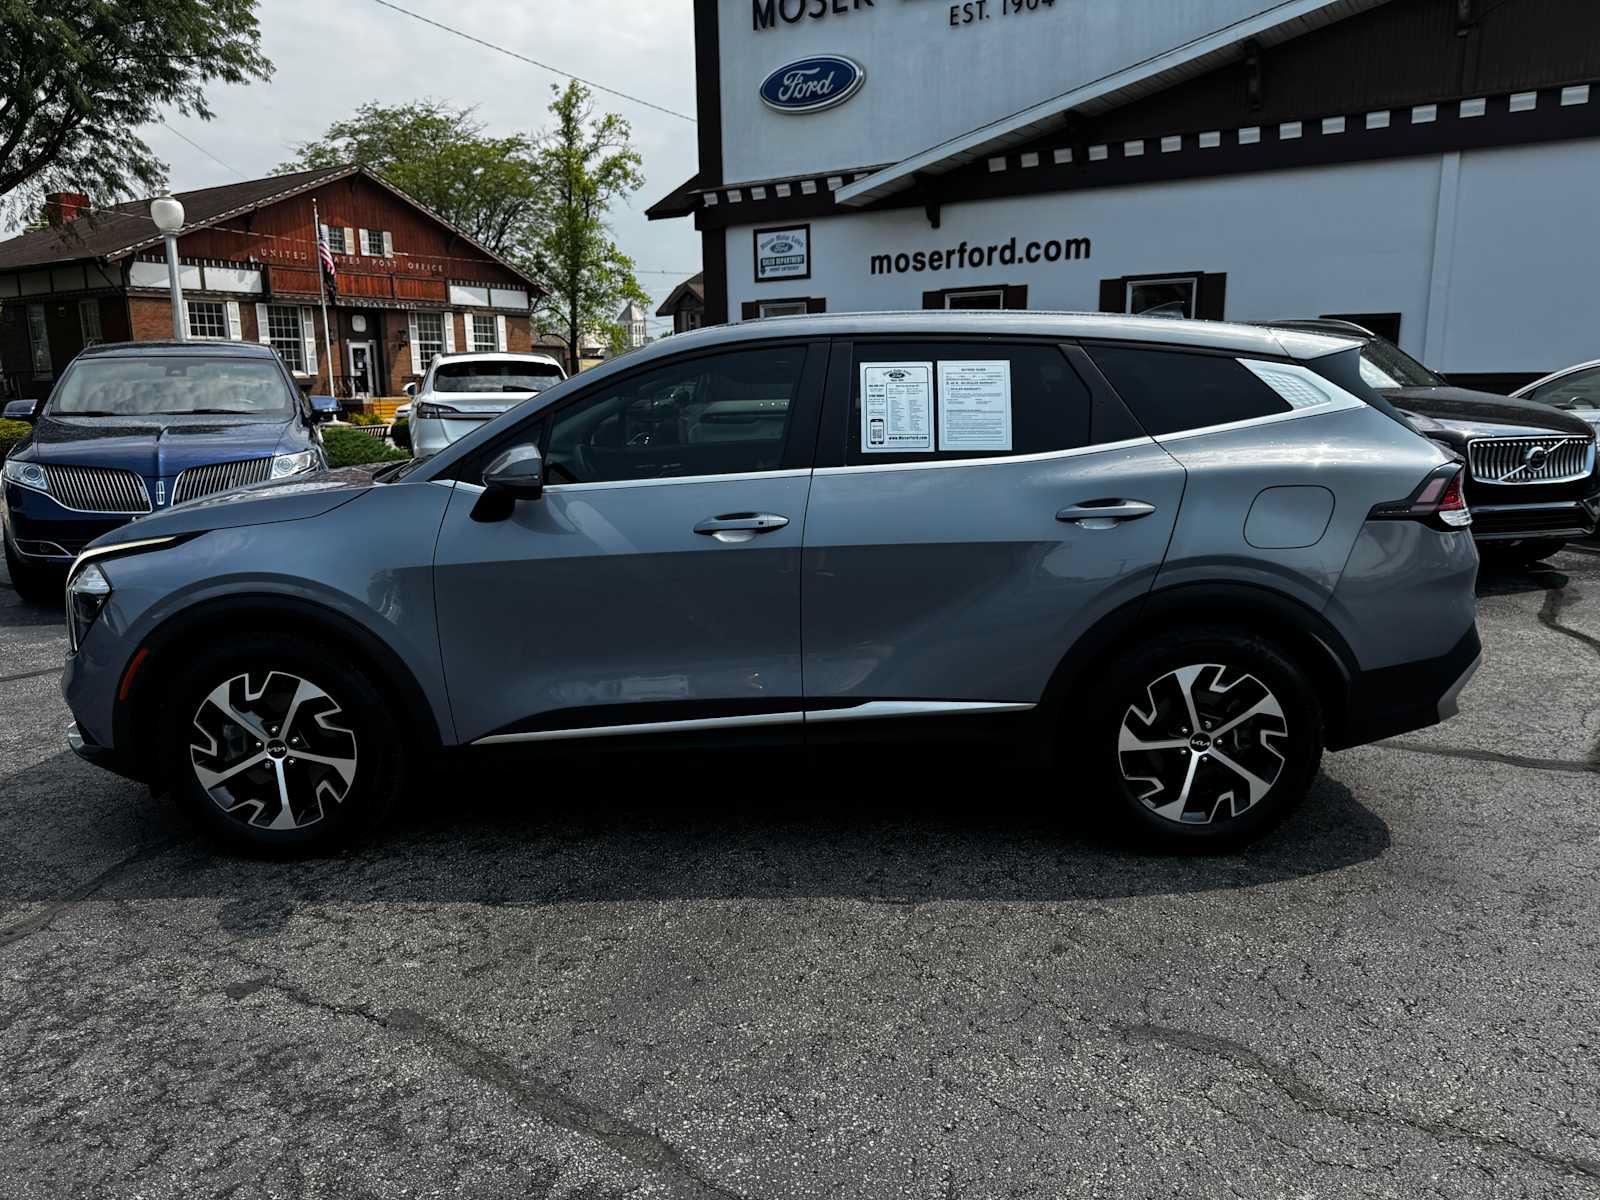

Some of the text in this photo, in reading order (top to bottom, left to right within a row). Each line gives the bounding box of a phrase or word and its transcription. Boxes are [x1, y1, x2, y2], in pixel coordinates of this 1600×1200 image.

[949, 0, 990, 26] EST.
[778, 67, 835, 101] Ford
[261, 247, 308, 261] UNITED
[372, 258, 398, 268] POST
[407, 261, 443, 273] OFFICE
[870, 237, 1092, 275] moserford.com
